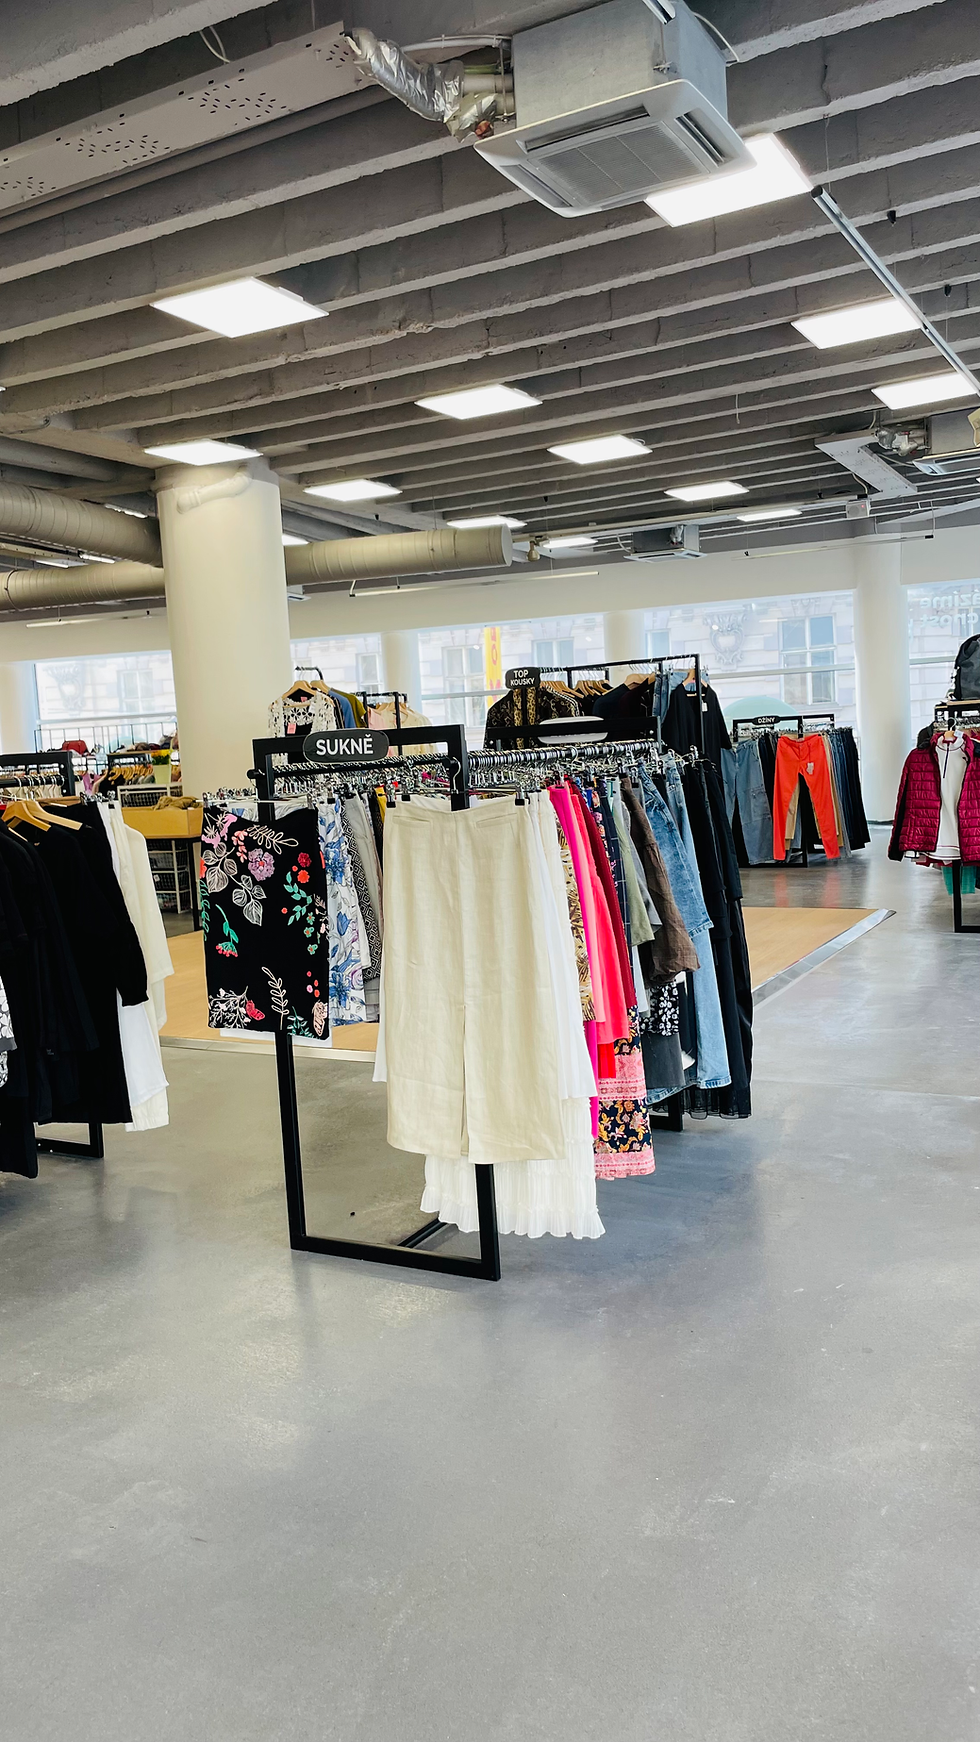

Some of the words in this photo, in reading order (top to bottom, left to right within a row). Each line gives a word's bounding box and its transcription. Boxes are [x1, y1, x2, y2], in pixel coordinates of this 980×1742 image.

[513, 669, 529, 678] TOP
[510, 677, 535, 686] KOUSKY
[316, 733, 374, 756] SUKNĚ
